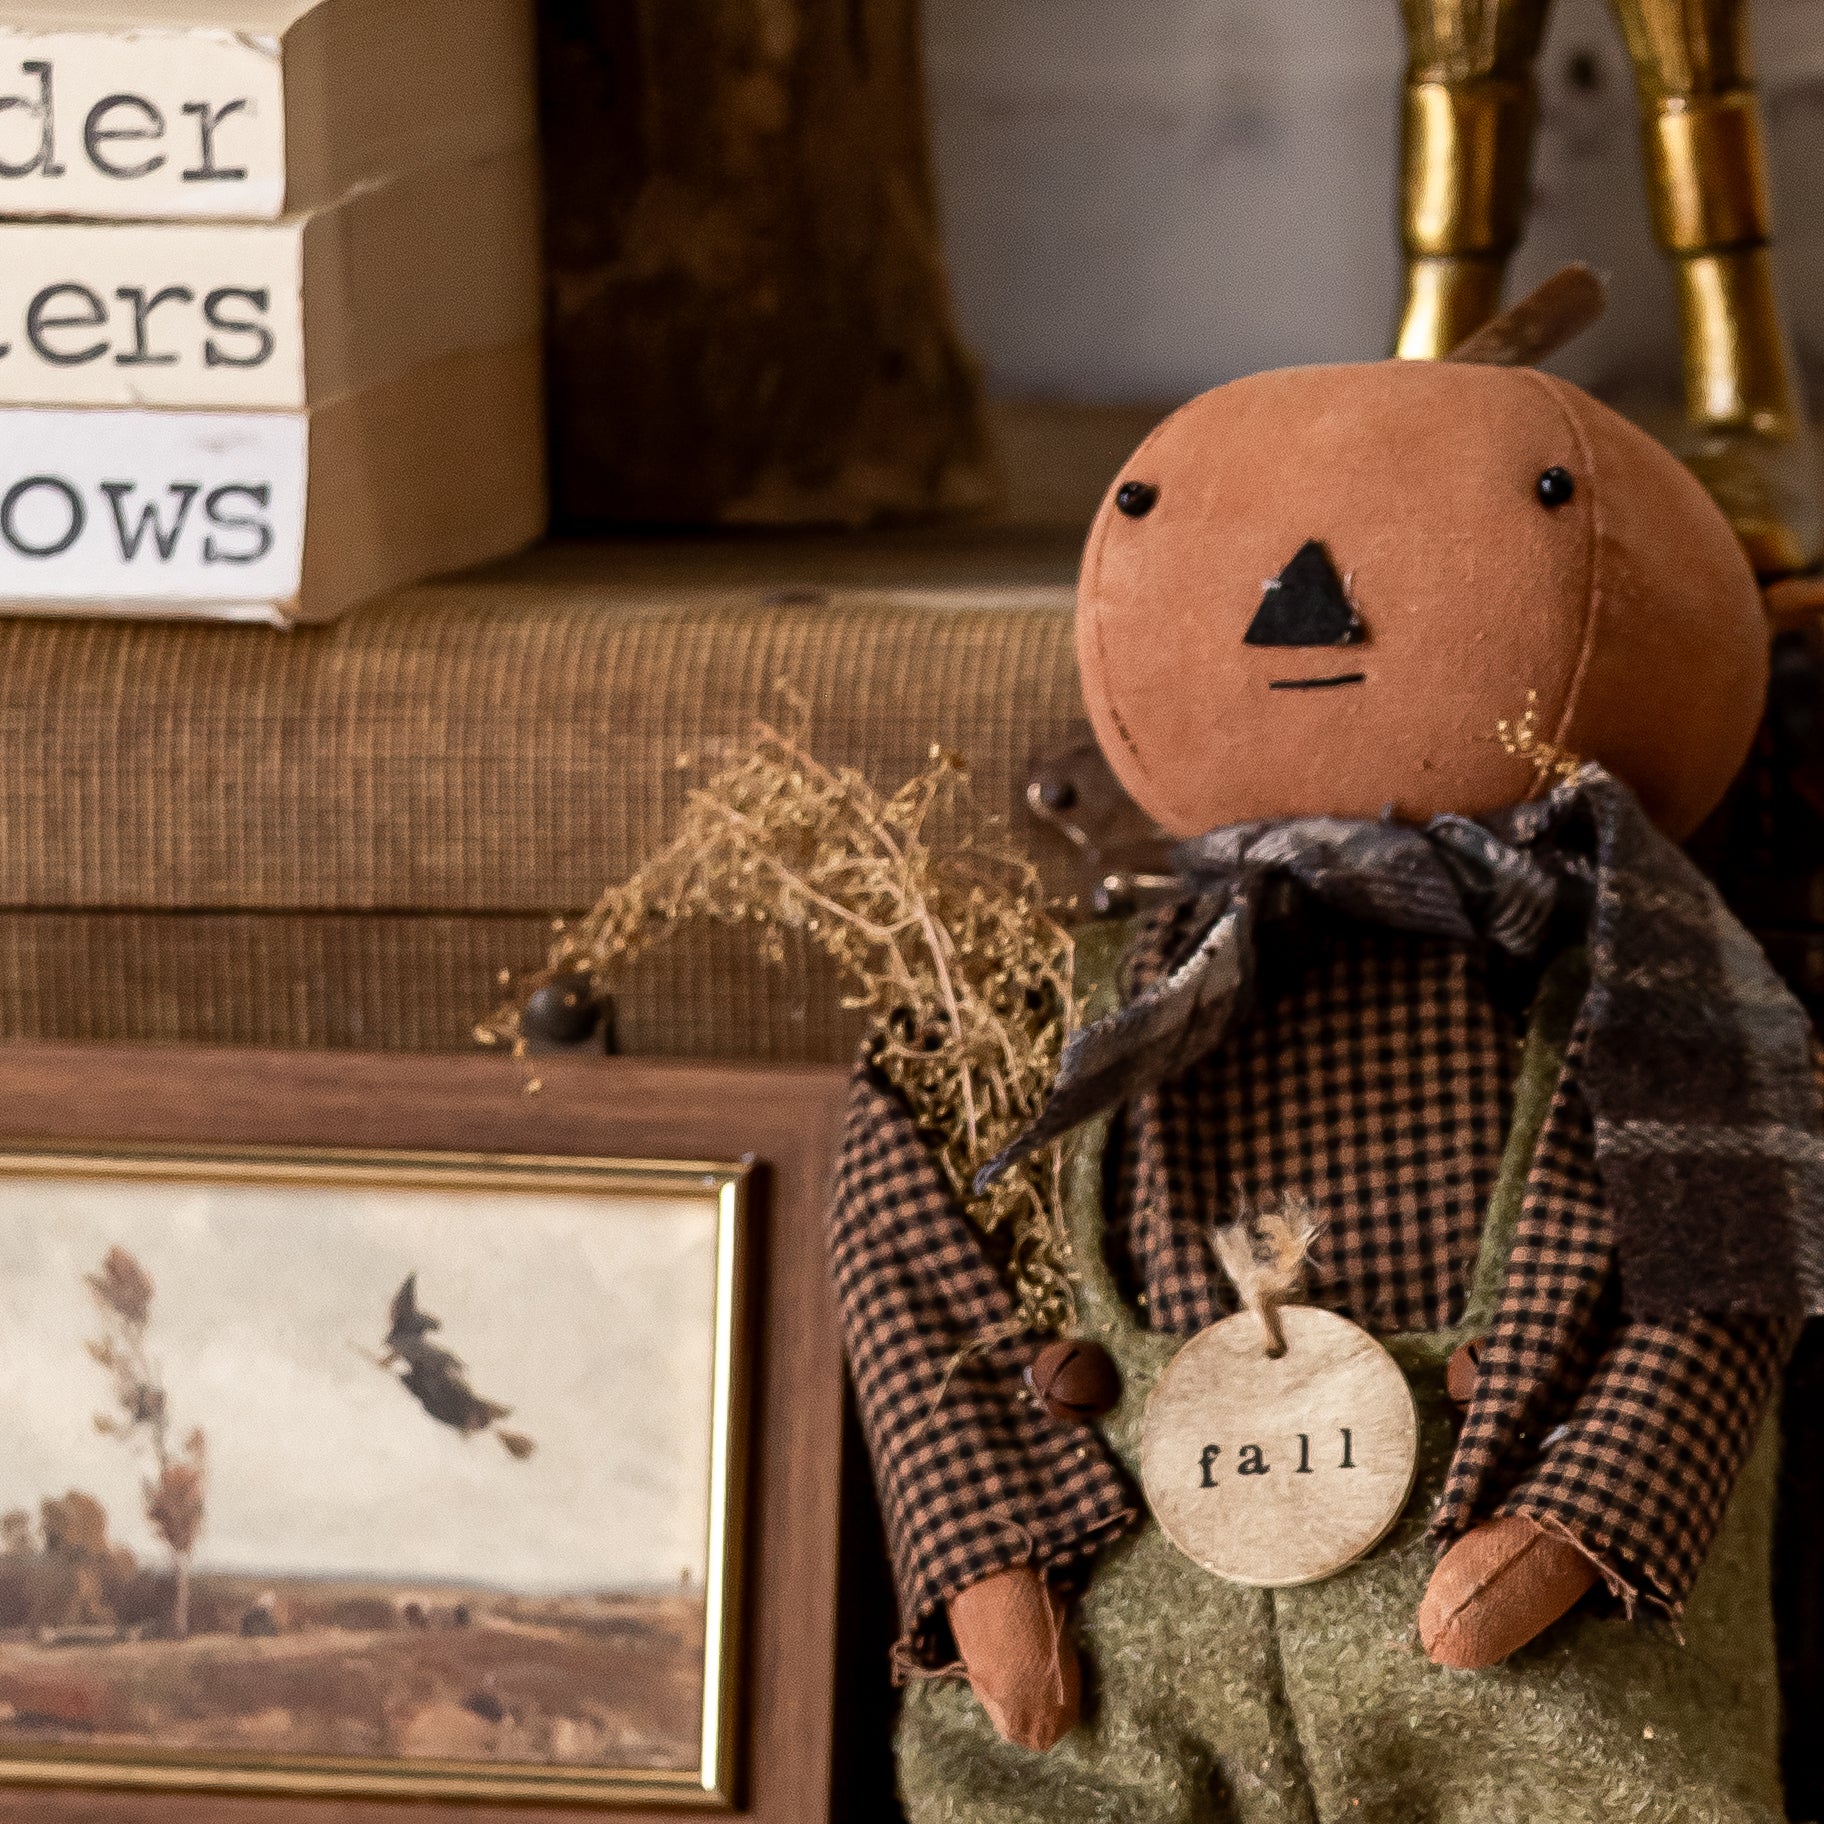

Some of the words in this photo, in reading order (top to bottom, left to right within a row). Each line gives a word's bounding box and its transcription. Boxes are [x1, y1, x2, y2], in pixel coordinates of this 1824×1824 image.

[0, 282, 275, 369] ers
[2, 475, 274, 565] ows
[1198, 1428, 1357, 1489] fall
